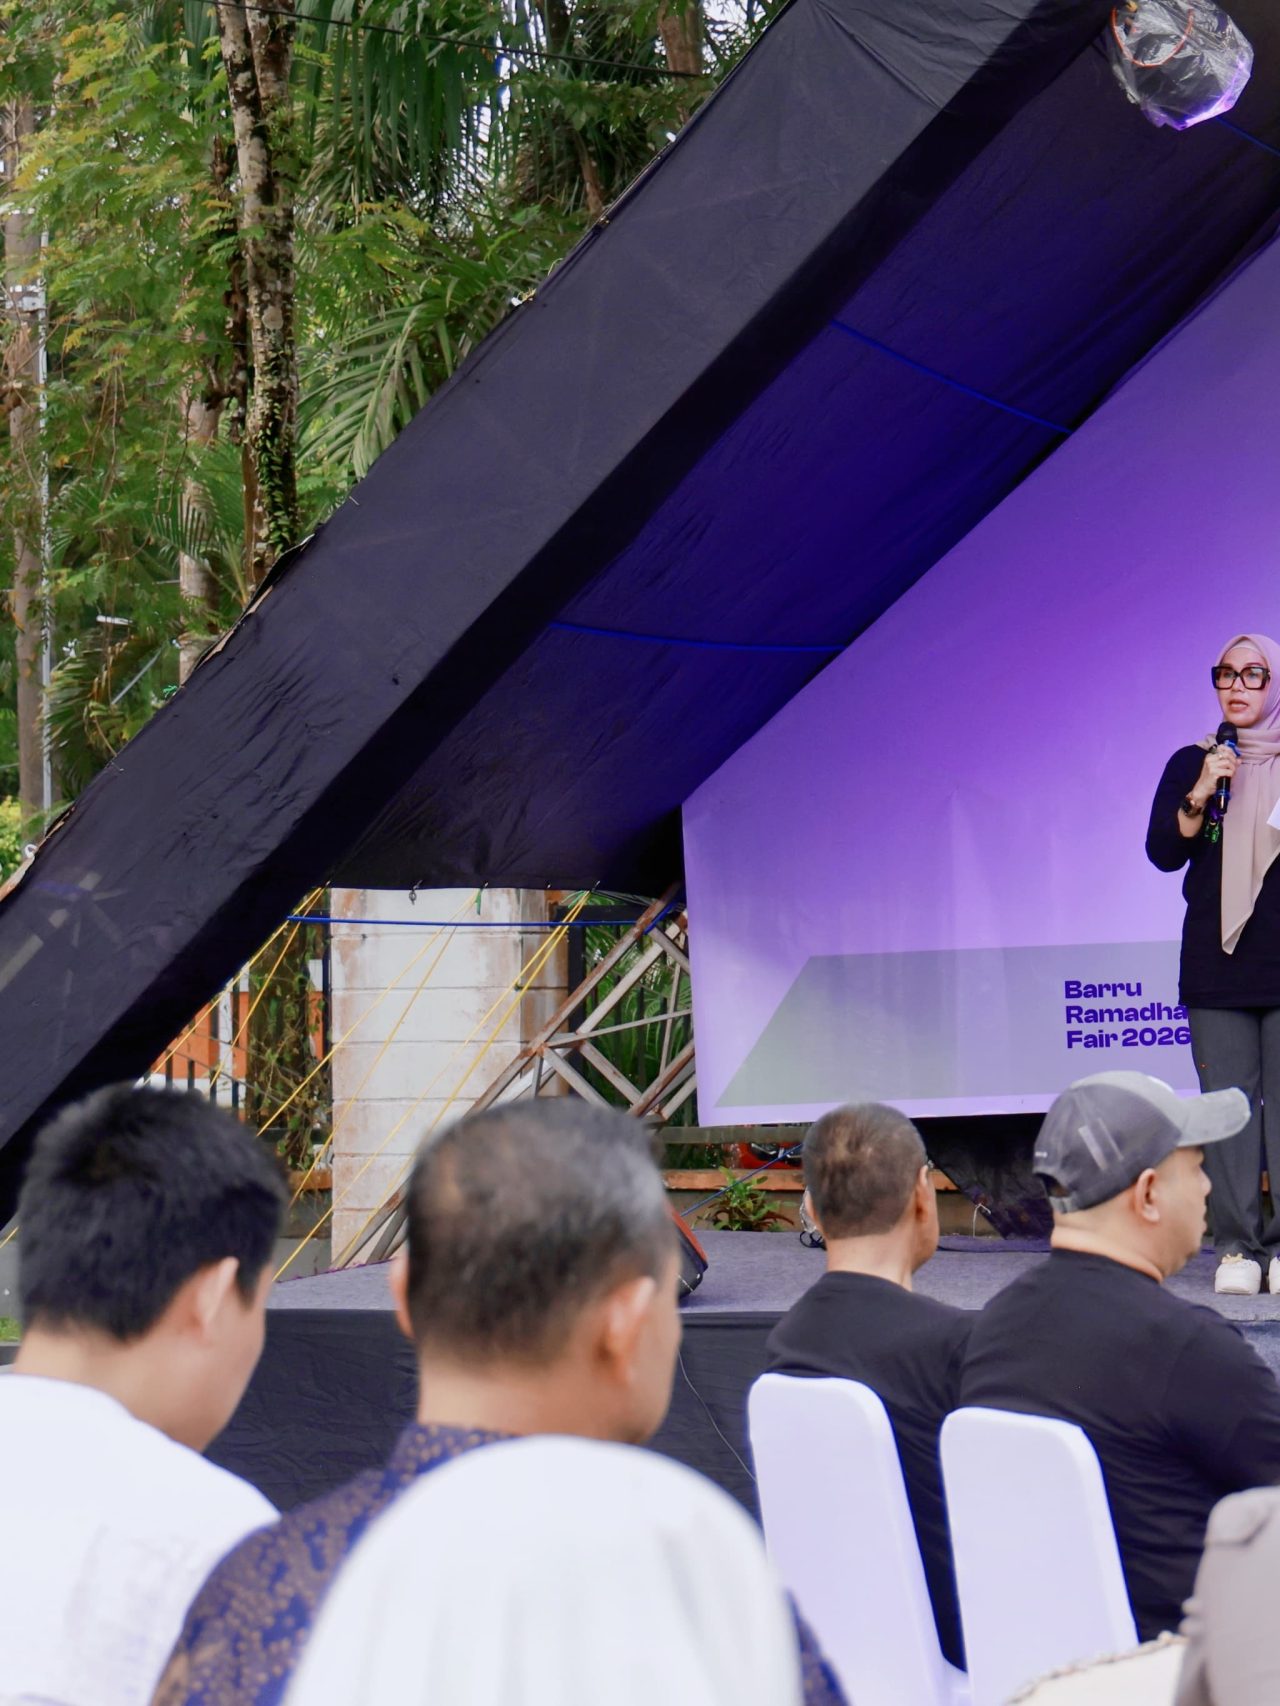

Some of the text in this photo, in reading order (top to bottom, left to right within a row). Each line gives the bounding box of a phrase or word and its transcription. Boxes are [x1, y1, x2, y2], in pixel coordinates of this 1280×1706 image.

[1064, 980, 1142, 999] Barru
[1066, 1002, 1188, 1024] Ramadha
[1067, 1026, 1191, 1048] Fair 2026
